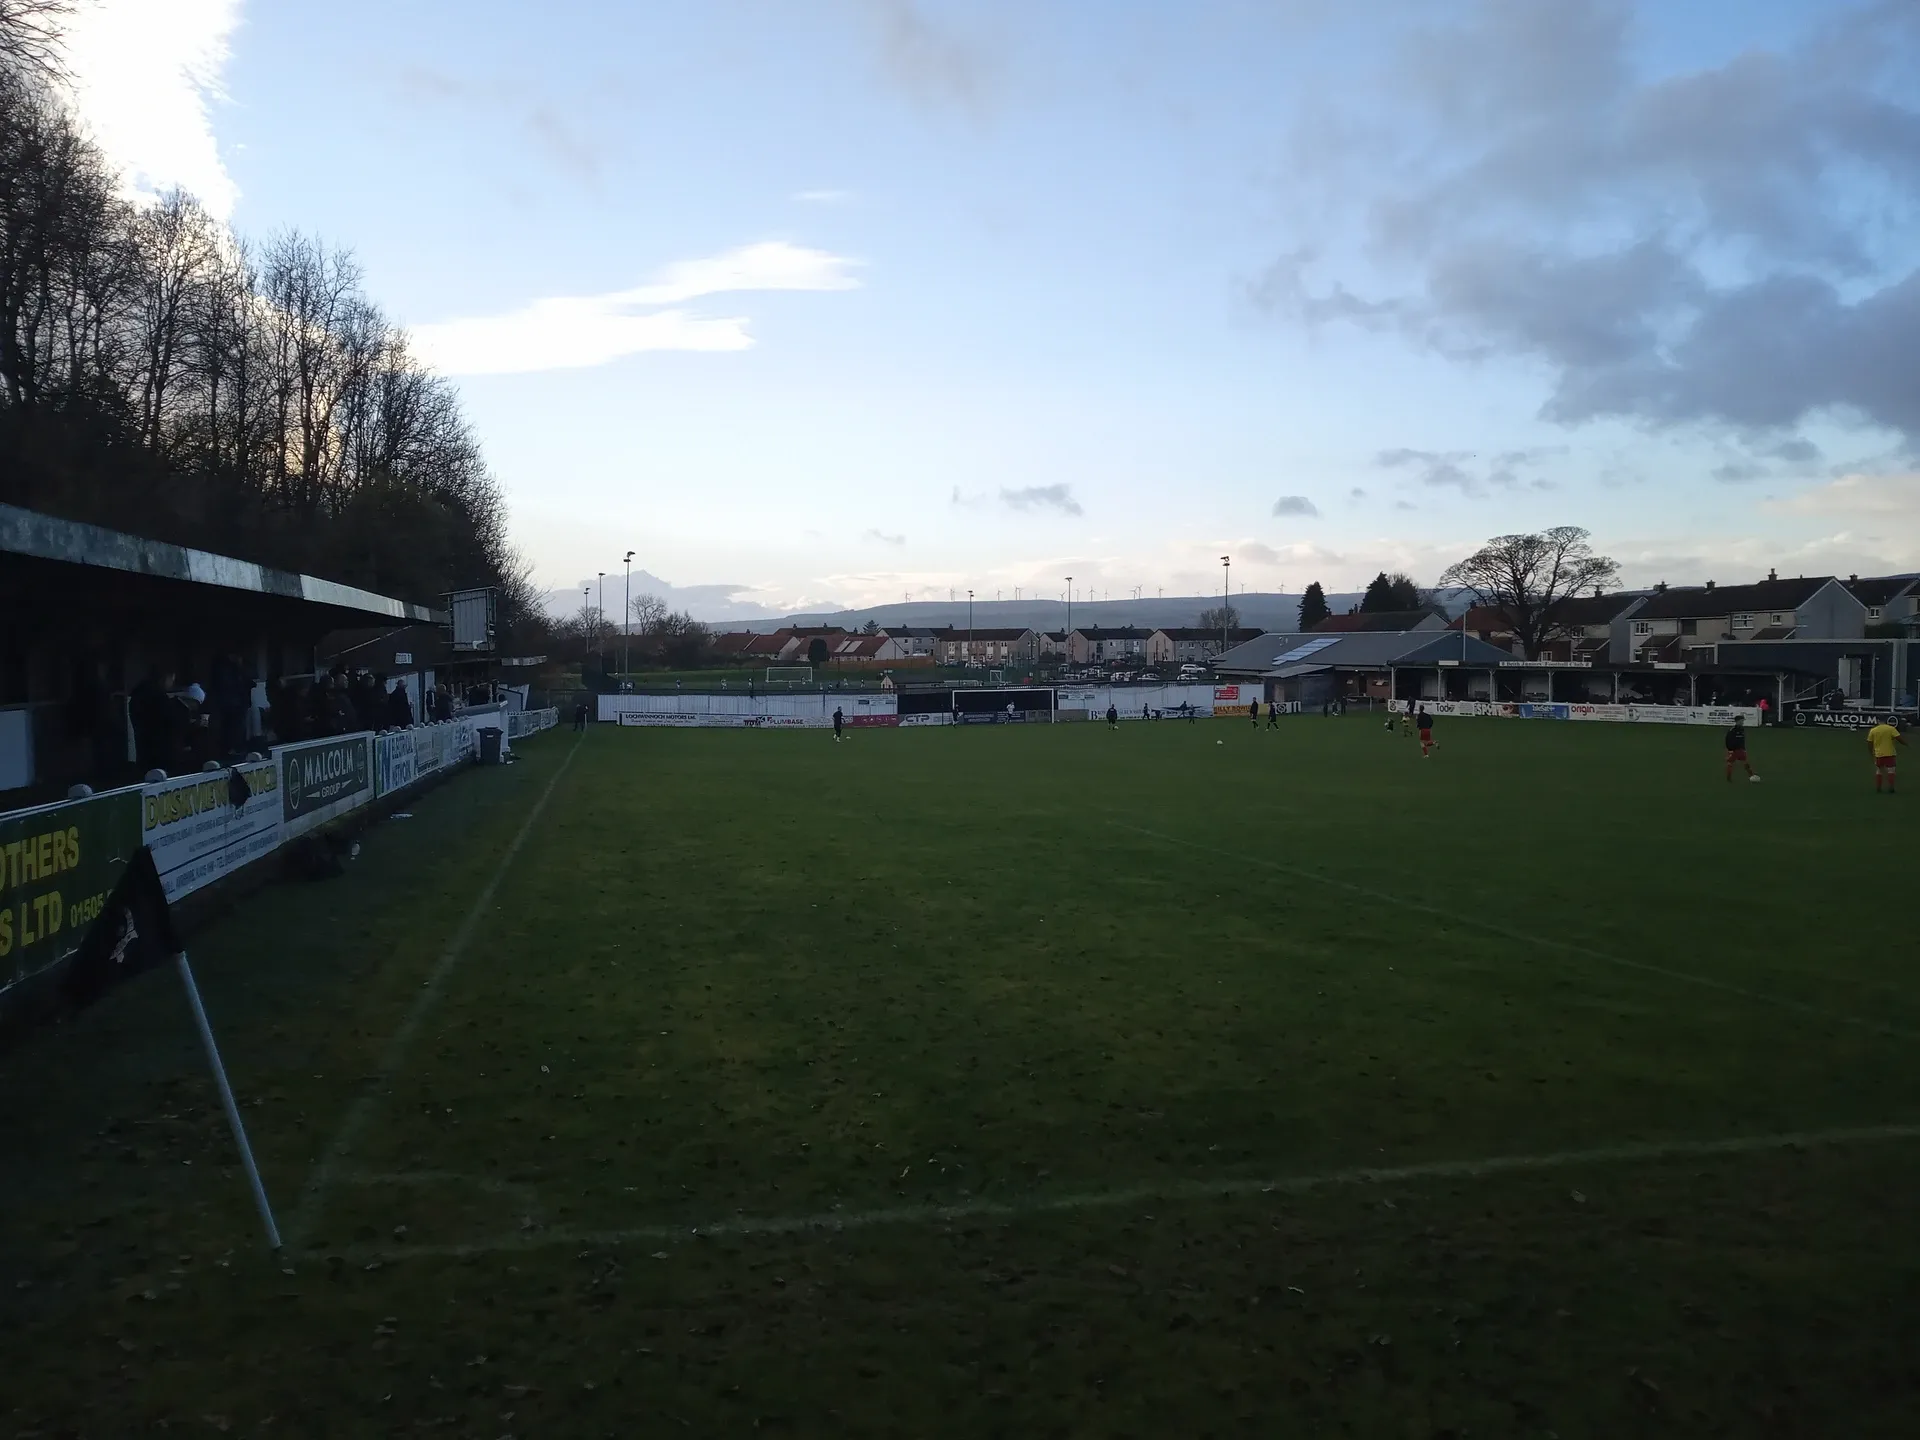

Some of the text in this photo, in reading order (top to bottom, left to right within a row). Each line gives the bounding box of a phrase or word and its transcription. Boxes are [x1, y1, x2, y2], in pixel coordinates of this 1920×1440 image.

[1571, 705, 1595, 716] origin
[905, 714, 930, 723] CTP
[1814, 713, 1877, 724] MALCOLM
[304, 748, 354, 788] MALCOLM
[321, 782, 341, 798] GROUP
[21, 890, 63, 947] LTD
